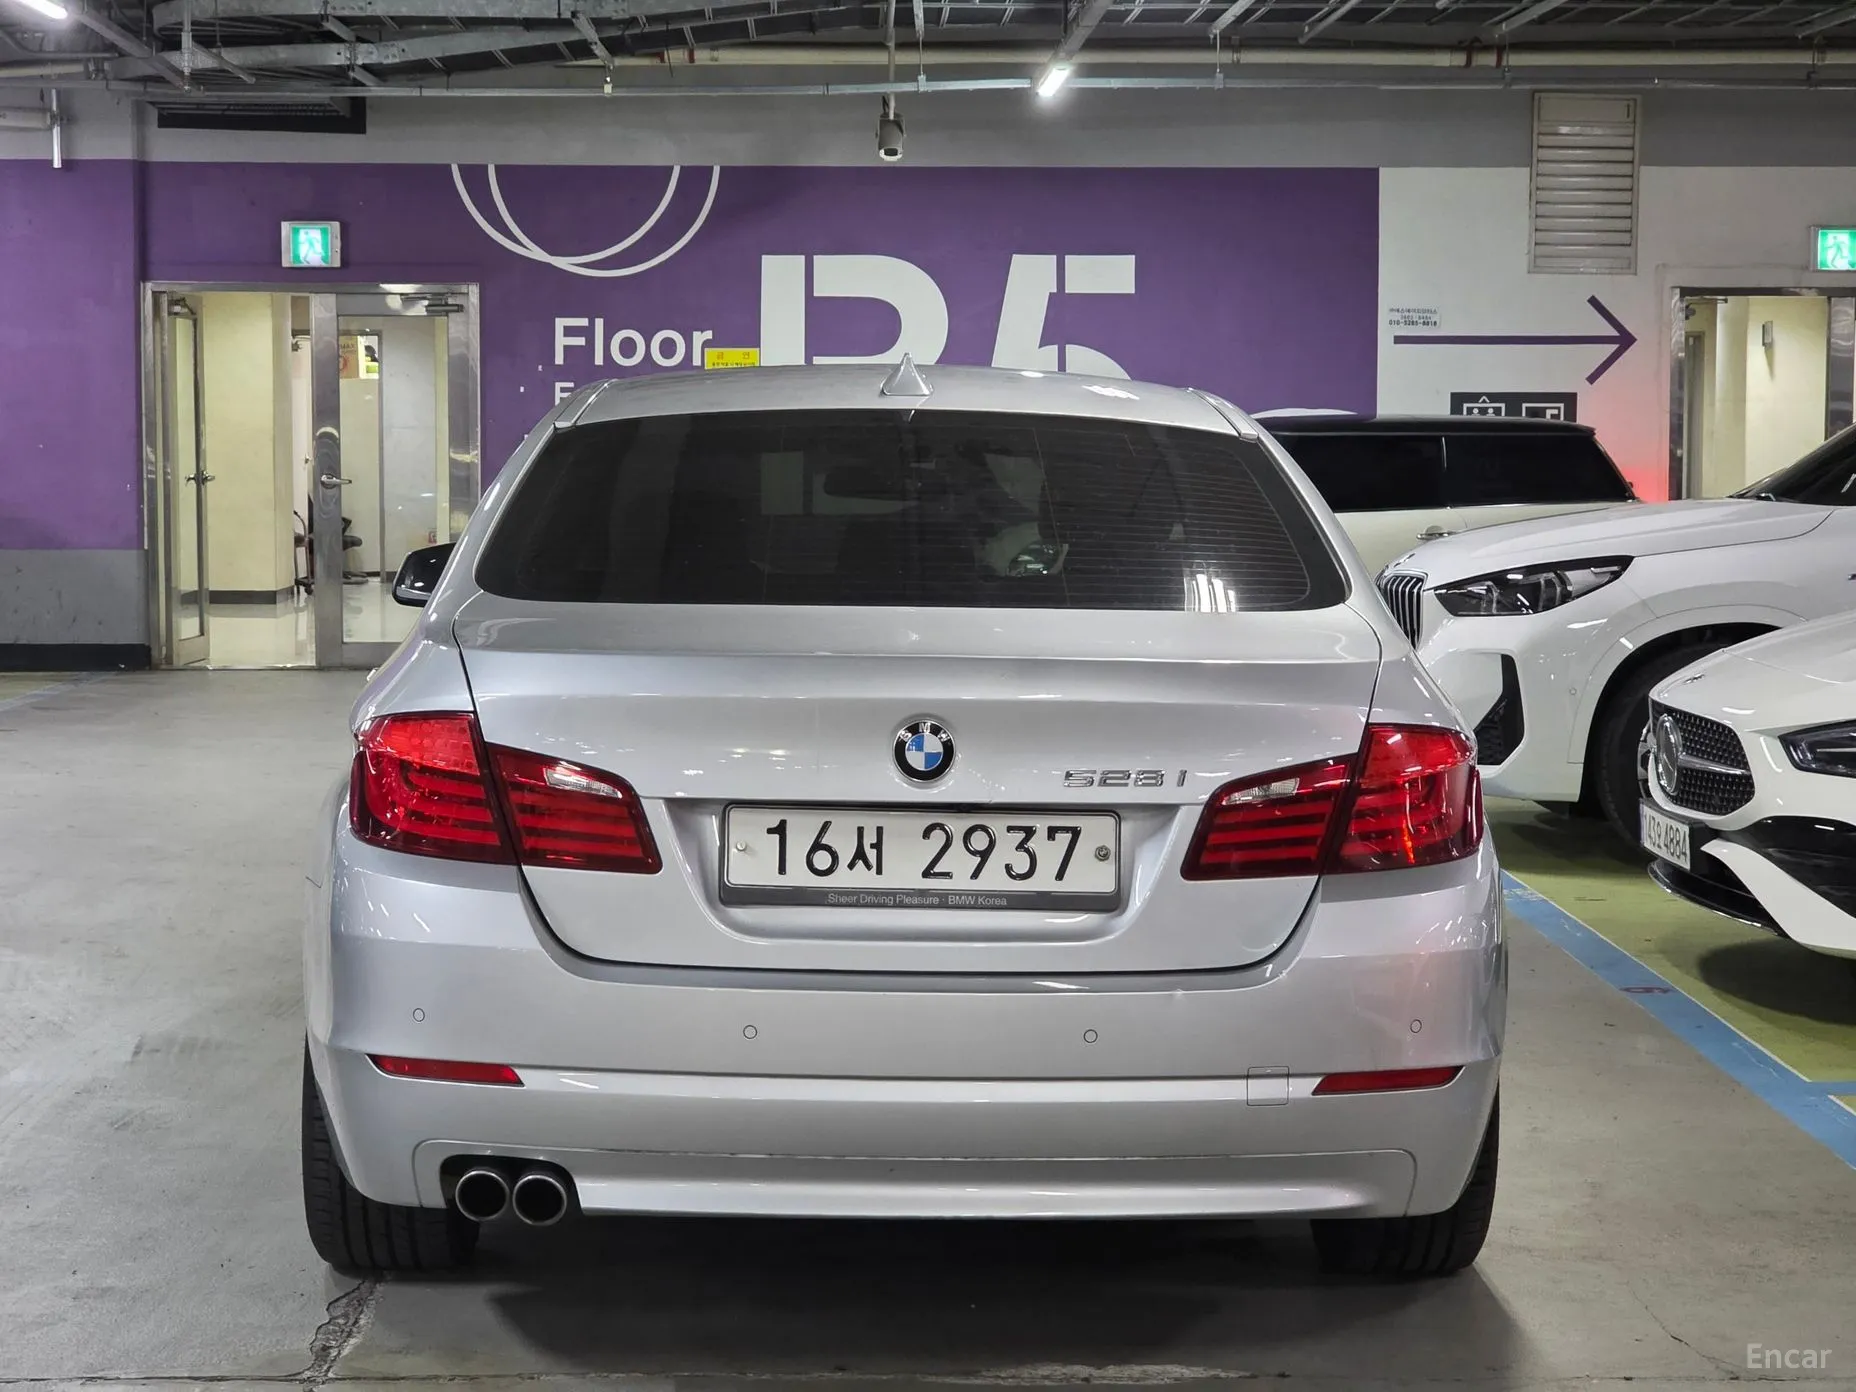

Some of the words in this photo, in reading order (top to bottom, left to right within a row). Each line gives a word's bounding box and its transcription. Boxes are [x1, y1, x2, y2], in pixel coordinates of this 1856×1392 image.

[554, 317, 713, 367] Floor
[766, 818, 884, 878] 16서
[921, 821, 1082, 881] 2937
[1664, 822, 1688, 863] 4884
[827, 893, 857, 903] Sheer
[859, 894, 894, 905] Driving
[896, 894, 940, 905] Pleasure
[948, 895, 976, 905] BMW
[977, 896, 1007, 906] Korea
